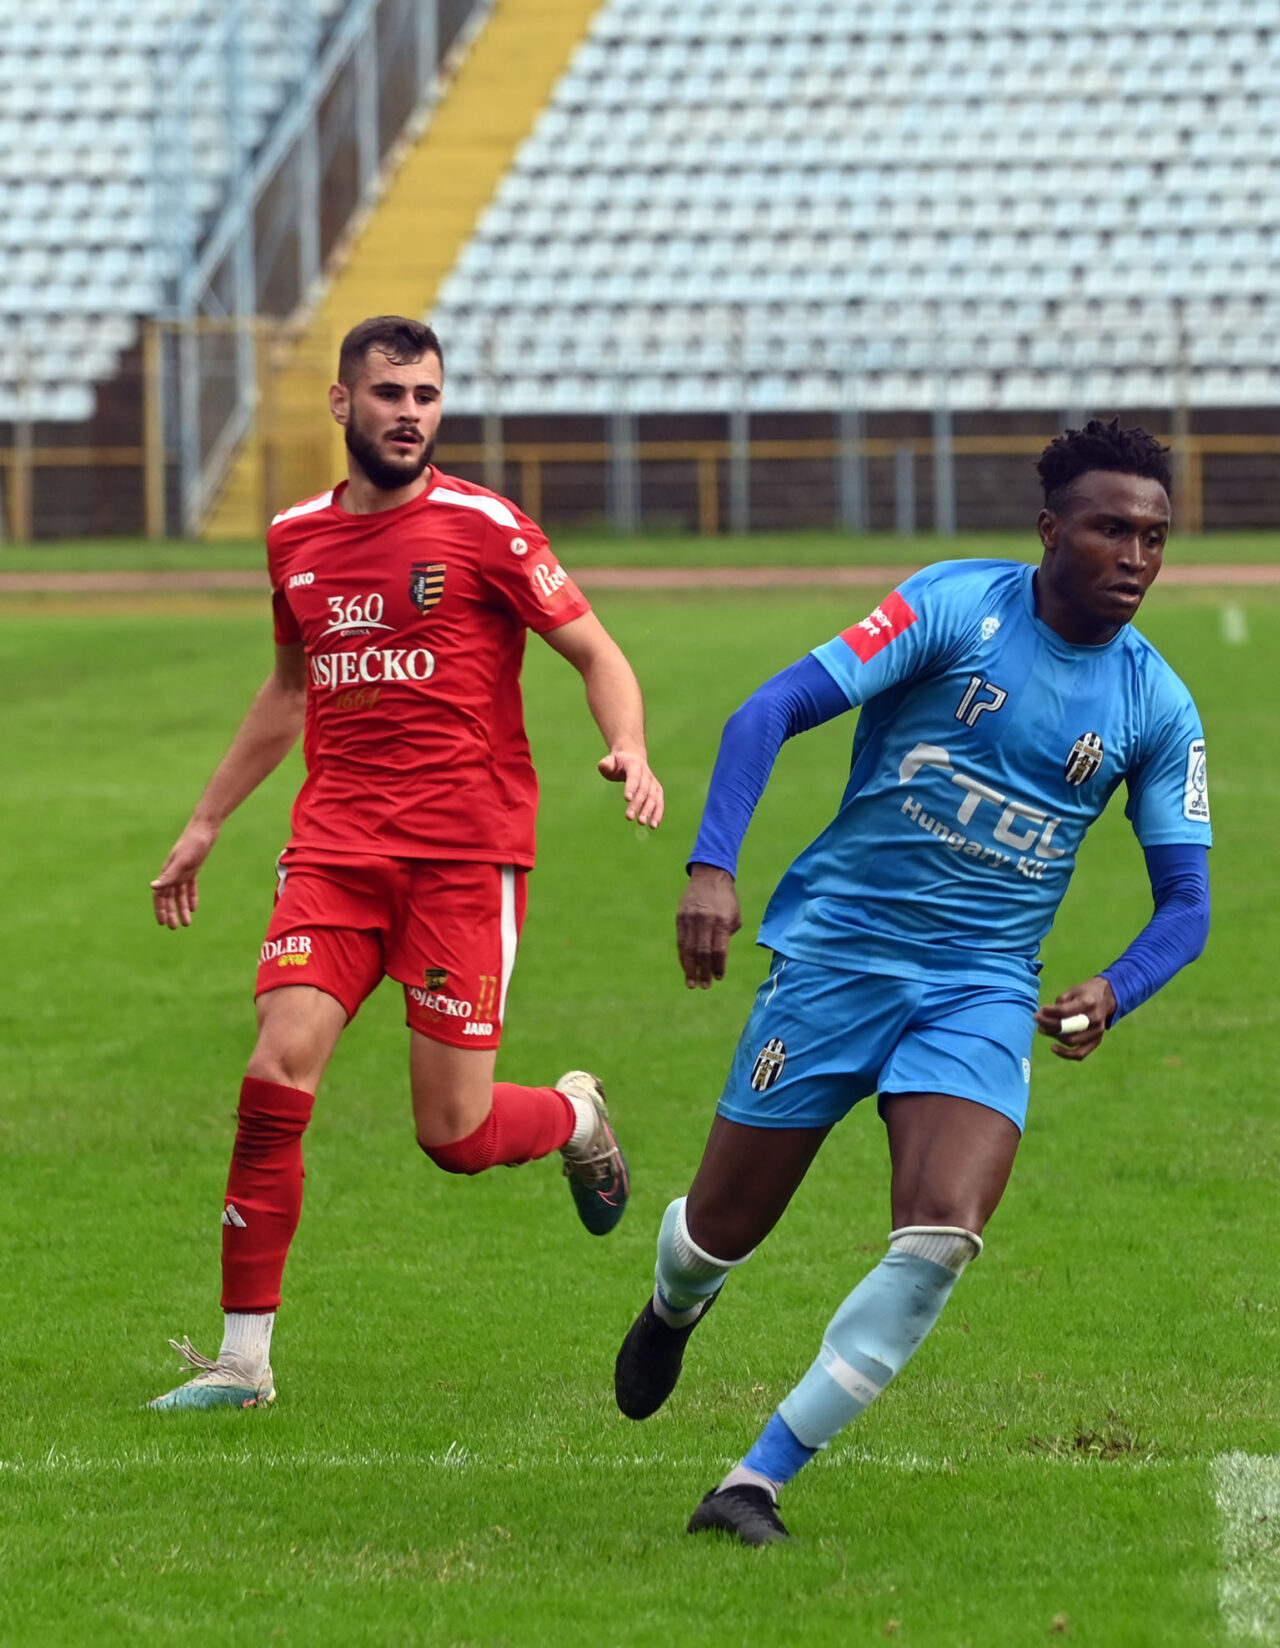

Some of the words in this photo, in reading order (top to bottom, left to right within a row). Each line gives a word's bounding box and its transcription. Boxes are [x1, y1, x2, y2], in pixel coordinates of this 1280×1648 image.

[288, 572, 315, 589] JAKO
[327, 593, 384, 626] 360
[311, 645, 435, 691] OSJEČKO
[954, 675, 1008, 728] 17
[901, 795, 1010, 868] Hungary
[474, 975, 498, 1020] 11
[462, 1021, 493, 1036] JAKO
